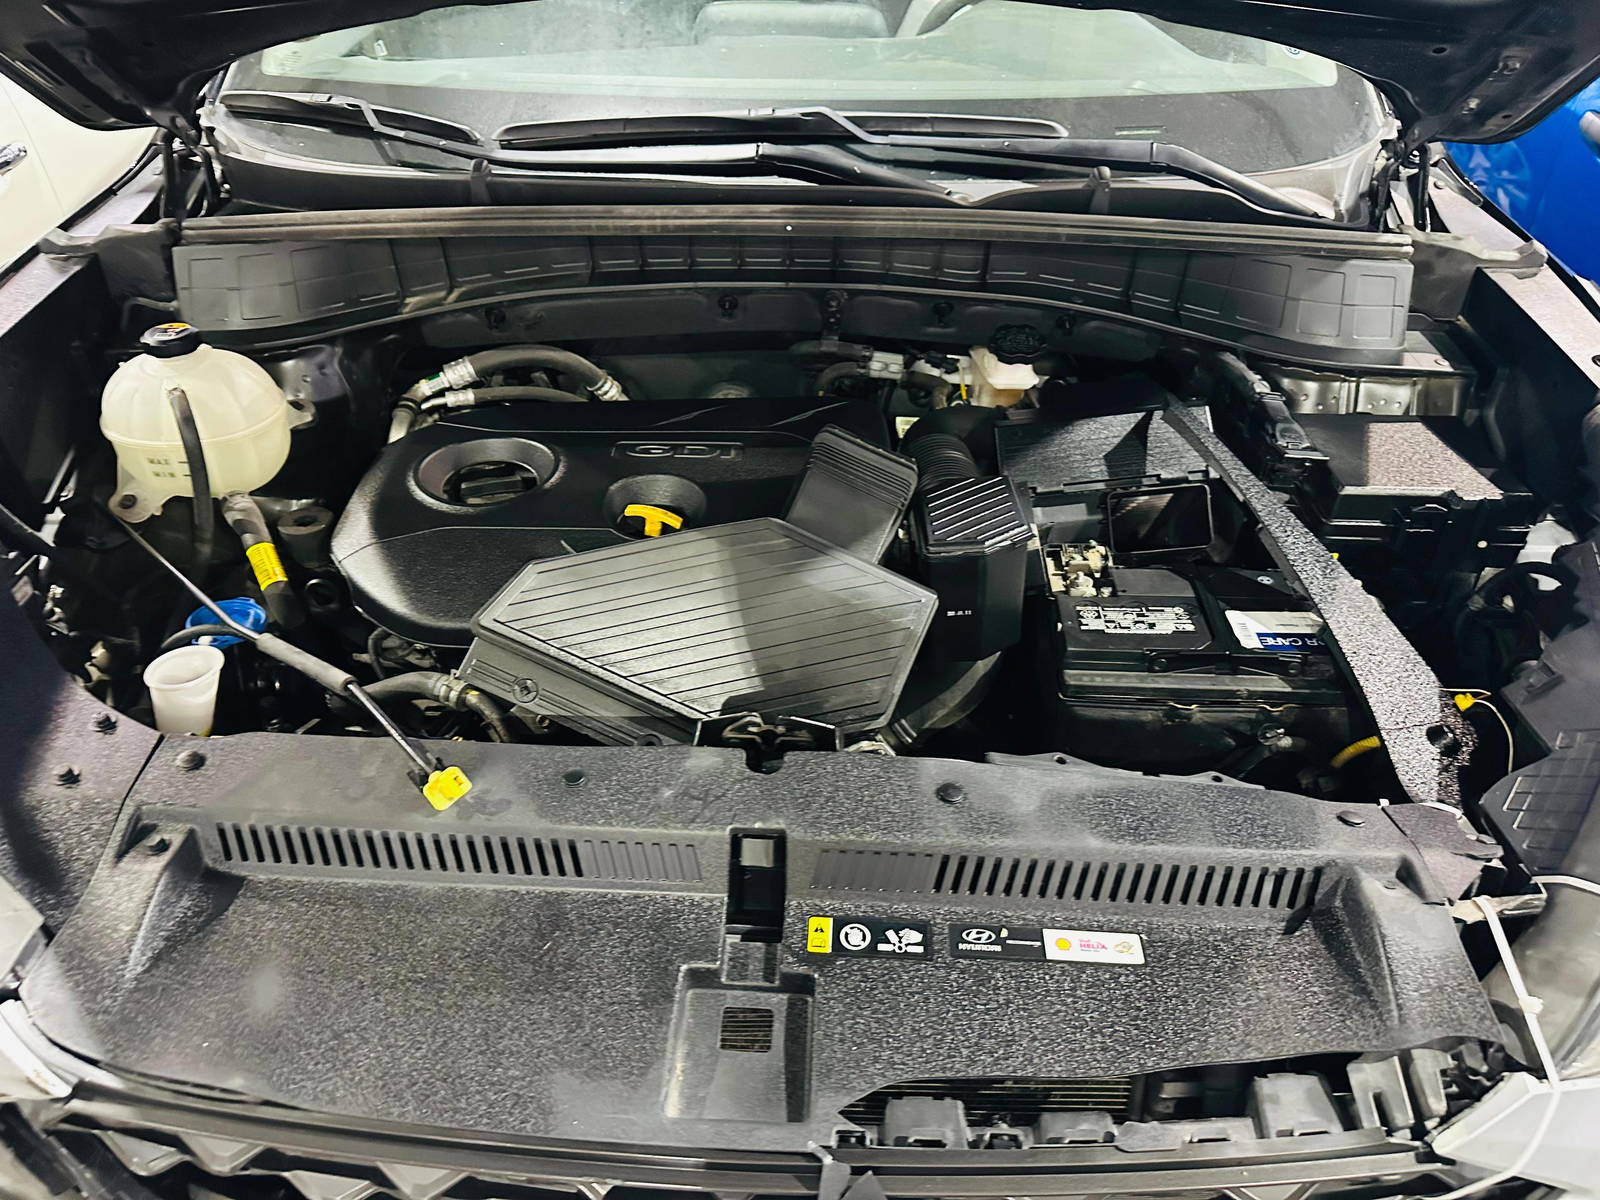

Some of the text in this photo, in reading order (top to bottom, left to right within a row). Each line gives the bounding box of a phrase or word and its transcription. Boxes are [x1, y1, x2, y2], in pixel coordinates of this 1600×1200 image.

[626, 445, 736, 458] GDI
[147, 457, 170, 465] MAX
[1261, 638, 1302, 646] CARE
[958, 943, 1002, 952] HYUNDAI
